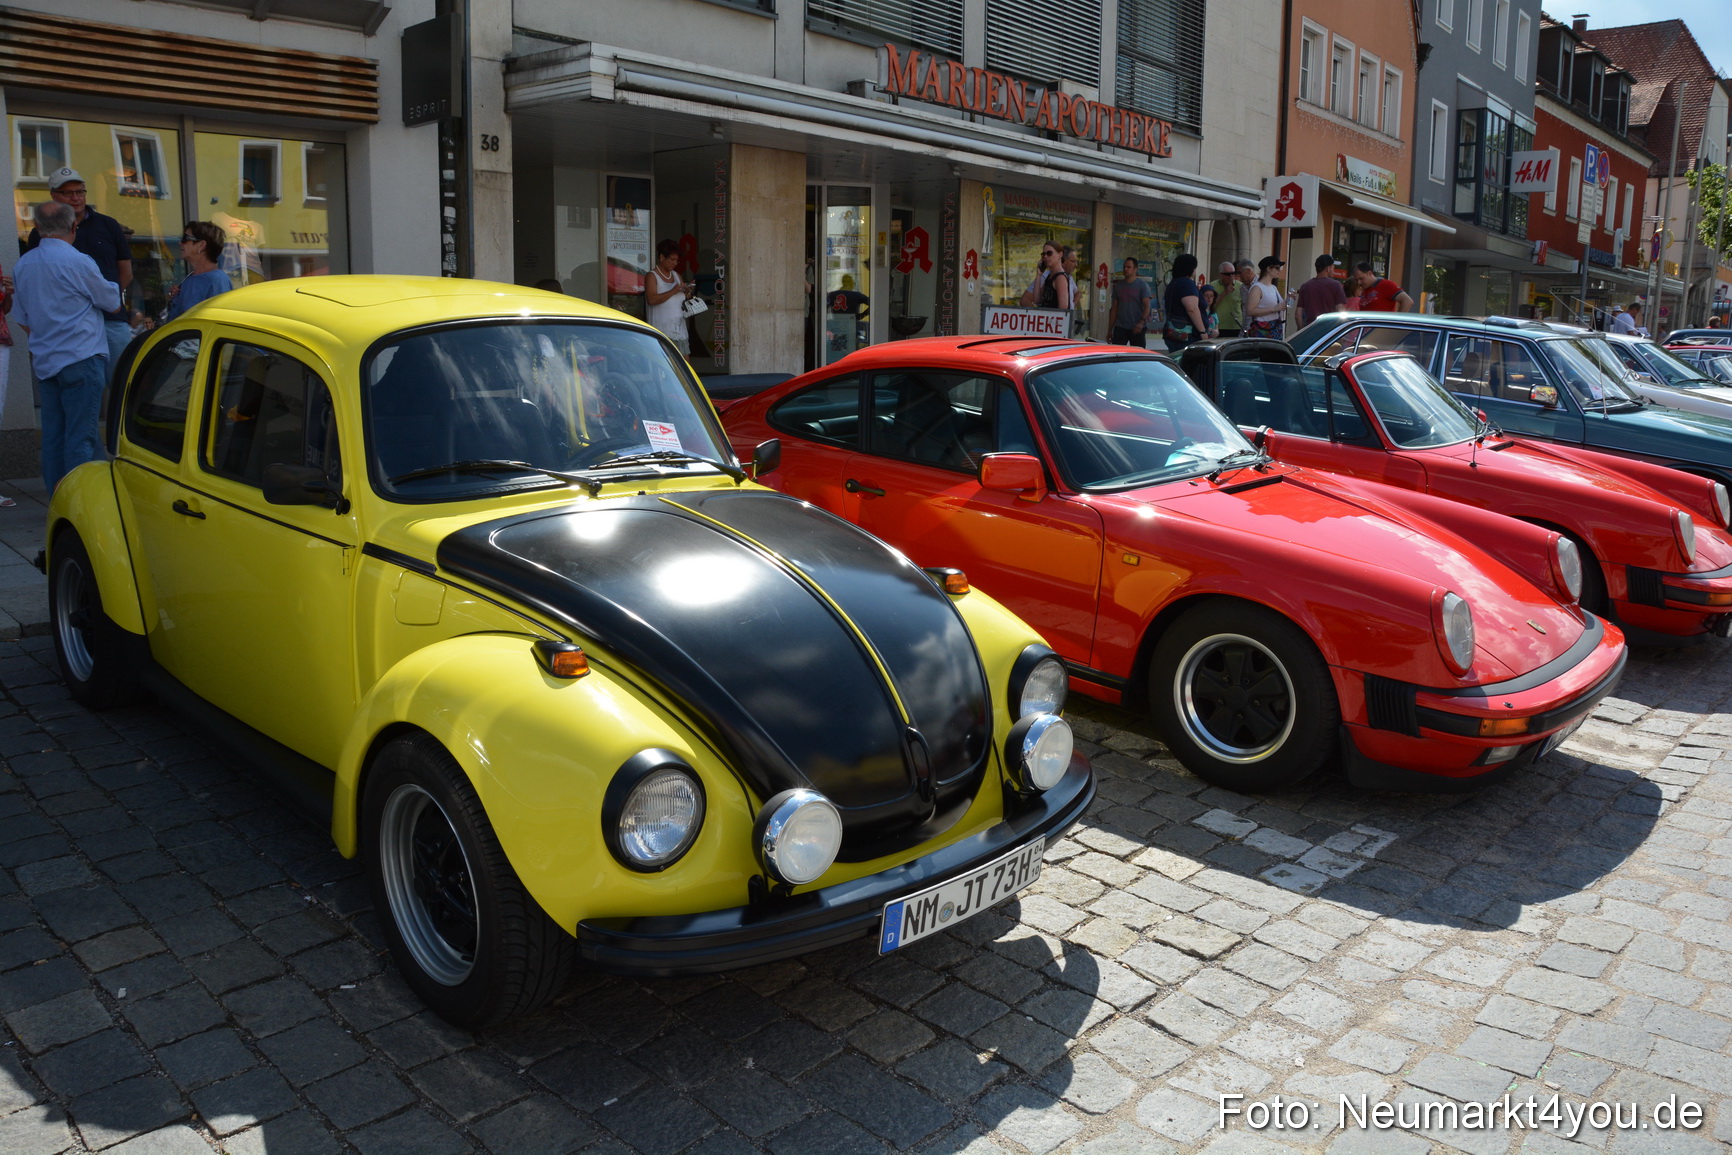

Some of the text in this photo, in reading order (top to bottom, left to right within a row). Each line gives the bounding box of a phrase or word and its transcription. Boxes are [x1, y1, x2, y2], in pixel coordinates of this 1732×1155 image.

[409, 99, 447, 119] ESPRIT
[884, 42, 1173, 158] MARIEN-APOTHEKE
[480, 133, 500, 152] 38
[1350, 171, 1362, 184] Nails
[1514, 158, 1552, 184] H&M
[1004, 192, 1040, 209] MARIEN
[943, 191, 955, 262] MARIEN
[610, 242, 648, 251] APOTHEKE
[714, 158, 727, 367] MARIEN APOTHEKE
[1373, 261, 1386, 273] NAILS
[990, 312, 1064, 334] APOTHEKE
[887, 848, 1032, 944] D NM JT 73H
